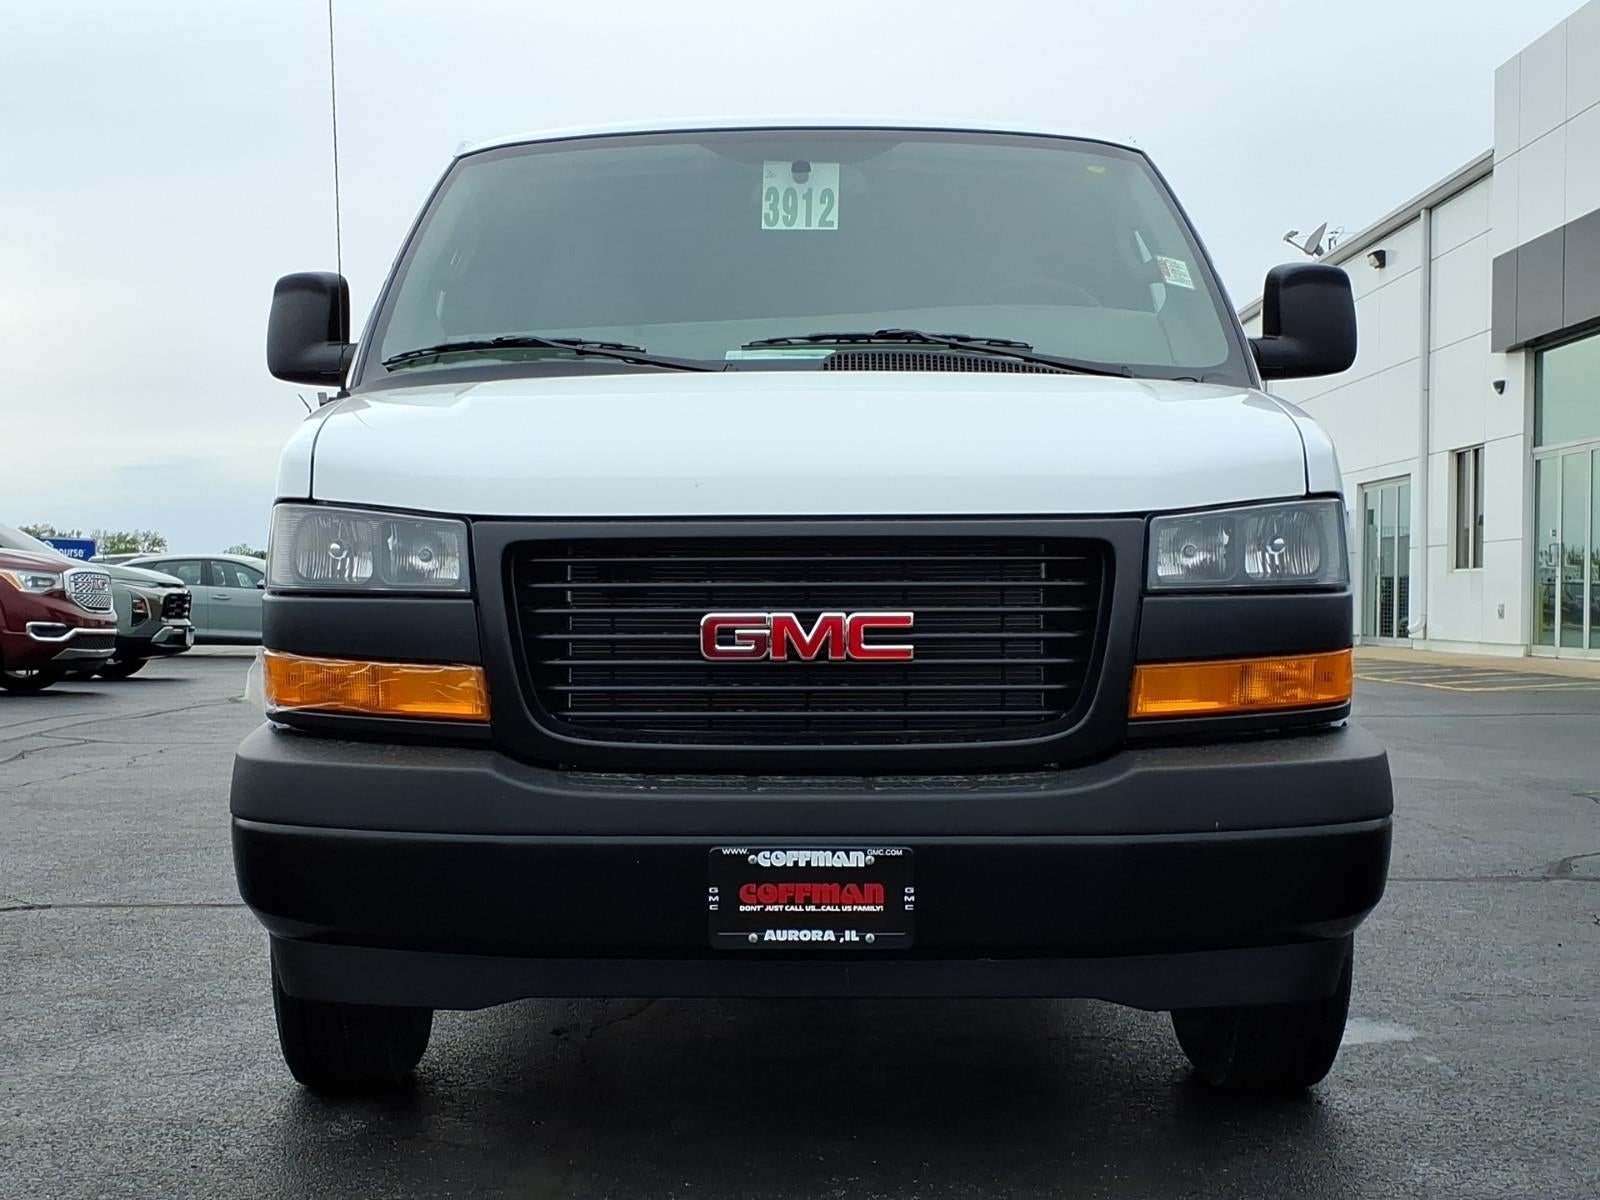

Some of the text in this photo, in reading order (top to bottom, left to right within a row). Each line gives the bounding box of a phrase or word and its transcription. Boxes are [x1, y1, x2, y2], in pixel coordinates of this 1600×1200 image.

[763, 185, 835, 228] 3912
[57, 548, 84, 558] ourse
[700, 611, 914, 661] GMC
[757, 850, 865, 868] COFFMAN
[867, 848, 903, 856] GMC.COM
[739, 883, 884, 904] COFFMAN
[764, 929, 836, 941] AURORA
